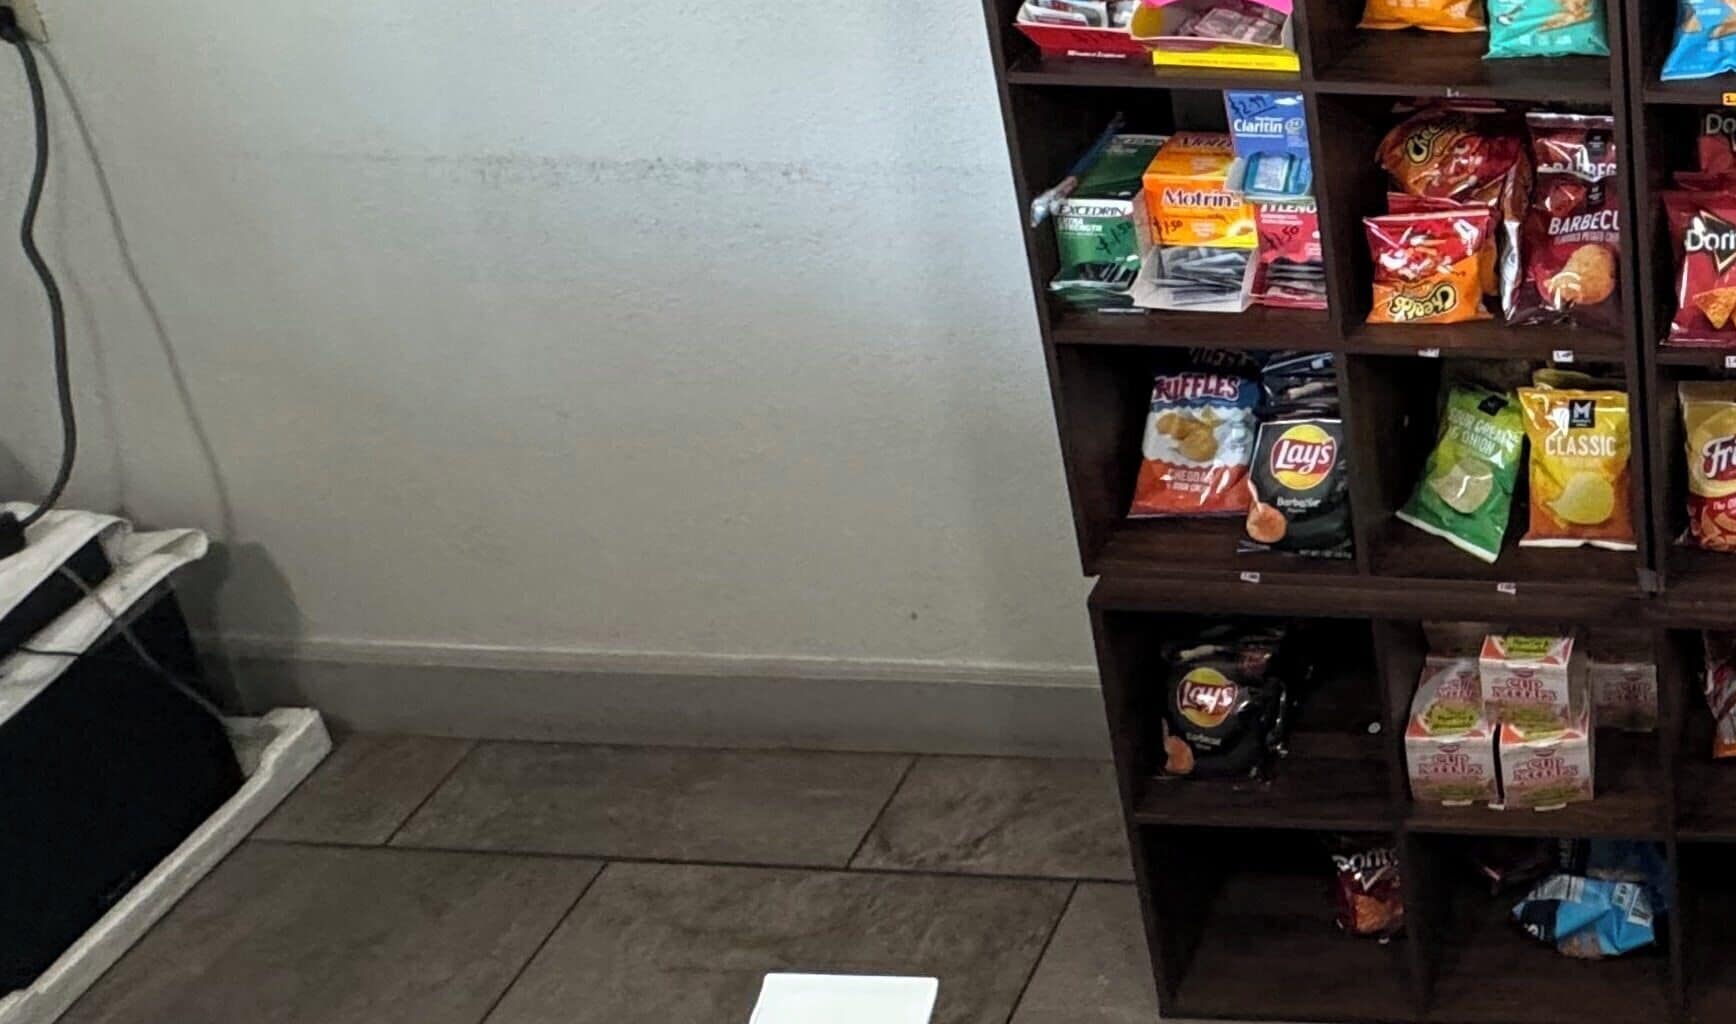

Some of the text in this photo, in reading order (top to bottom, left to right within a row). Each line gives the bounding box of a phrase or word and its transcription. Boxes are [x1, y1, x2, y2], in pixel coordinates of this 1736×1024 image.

[1233, 118, 1283, 133] Claritin
[1164, 188, 1232, 208] Motrin
[1058, 204, 1128, 216] EXCEDRIN
[1152, 372, 1241, 403] RUFFLES
[1545, 436, 1617, 457] CLASSIC
[1275, 439, 1334, 475] Lay's
[1506, 678, 1543, 690] CUP
[1182, 680, 1234, 714] Lay's
[1432, 753, 1470, 765] CUP
[1526, 758, 1565, 769] CUP
